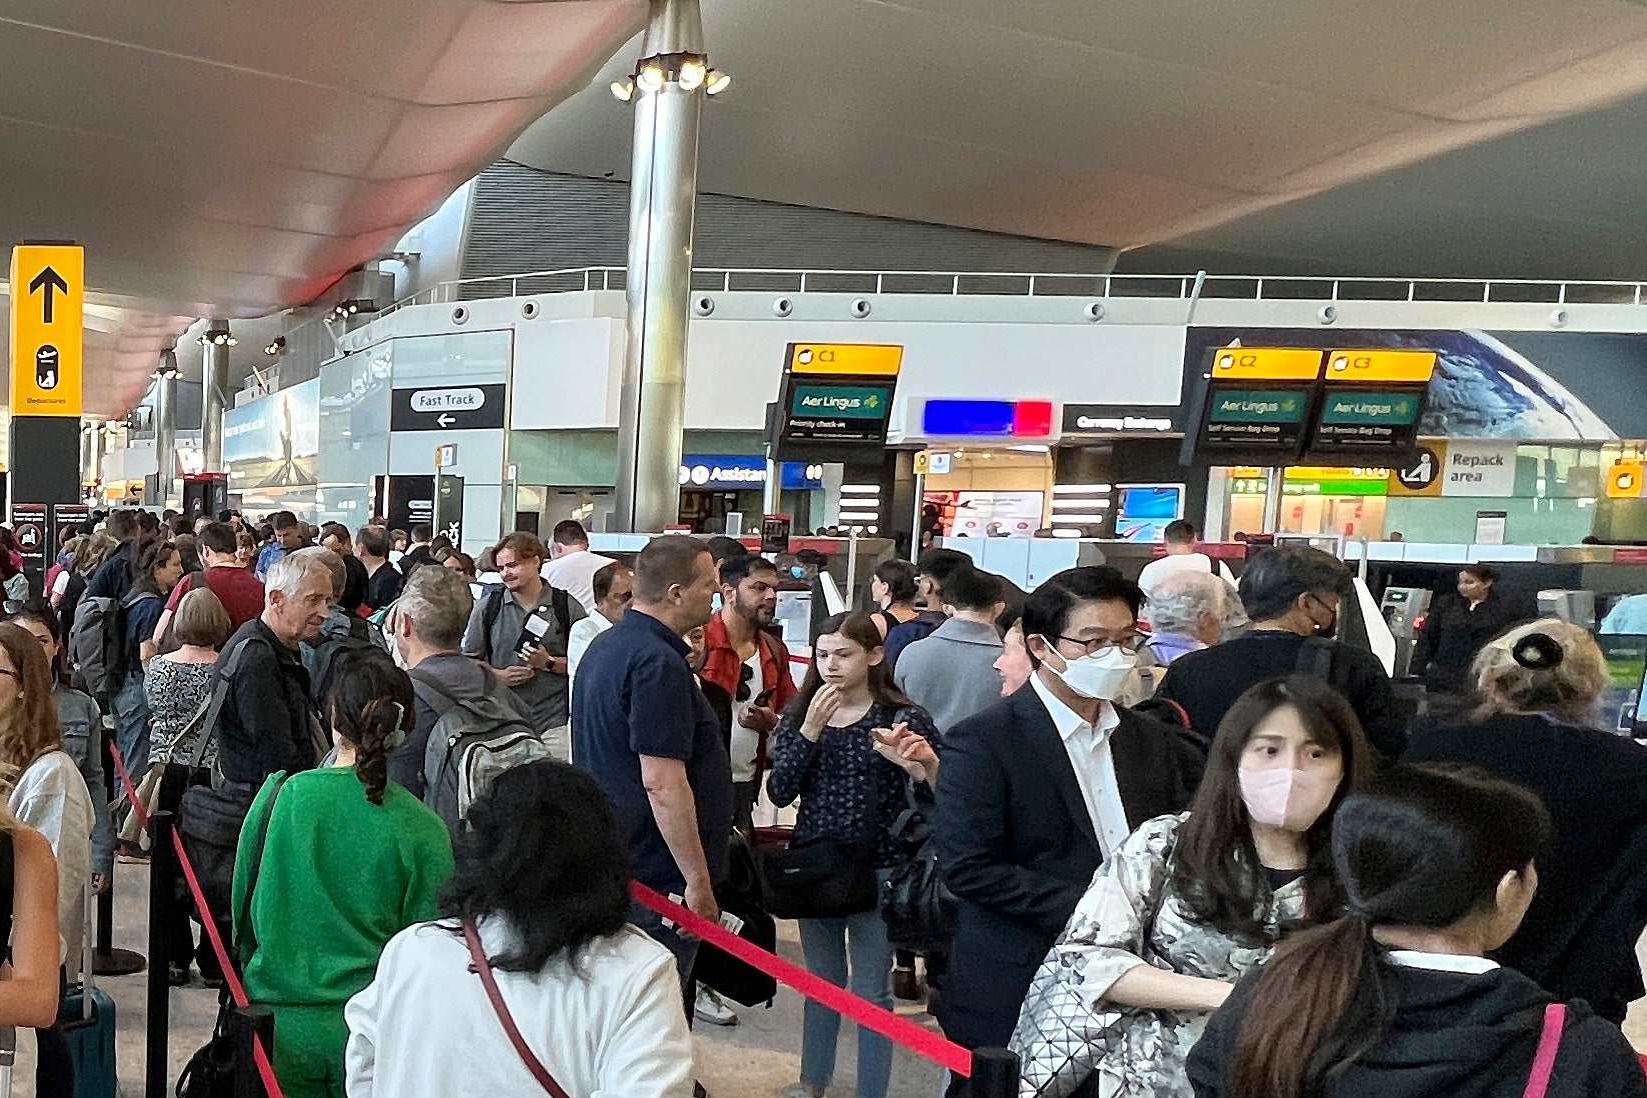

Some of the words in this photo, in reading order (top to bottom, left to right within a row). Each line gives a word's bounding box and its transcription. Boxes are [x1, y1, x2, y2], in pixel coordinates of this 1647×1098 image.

[818, 350, 836, 362] C1
[1239, 356, 1257, 368] C2
[1353, 357, 1371, 369] C3
[419, 395, 442, 407] Fast
[444, 393, 475, 406] Track
[801, 395, 823, 407] Aer
[823, 395, 861, 410] Lingus
[1221, 400, 1242, 412] Aer
[1242, 400, 1279, 414] Lingus
[1333, 402, 1354, 413] Aer
[1354, 403, 1392, 416] Lingus
[1452, 452, 1504, 467] Repack
[1450, 471, 1483, 483] area
